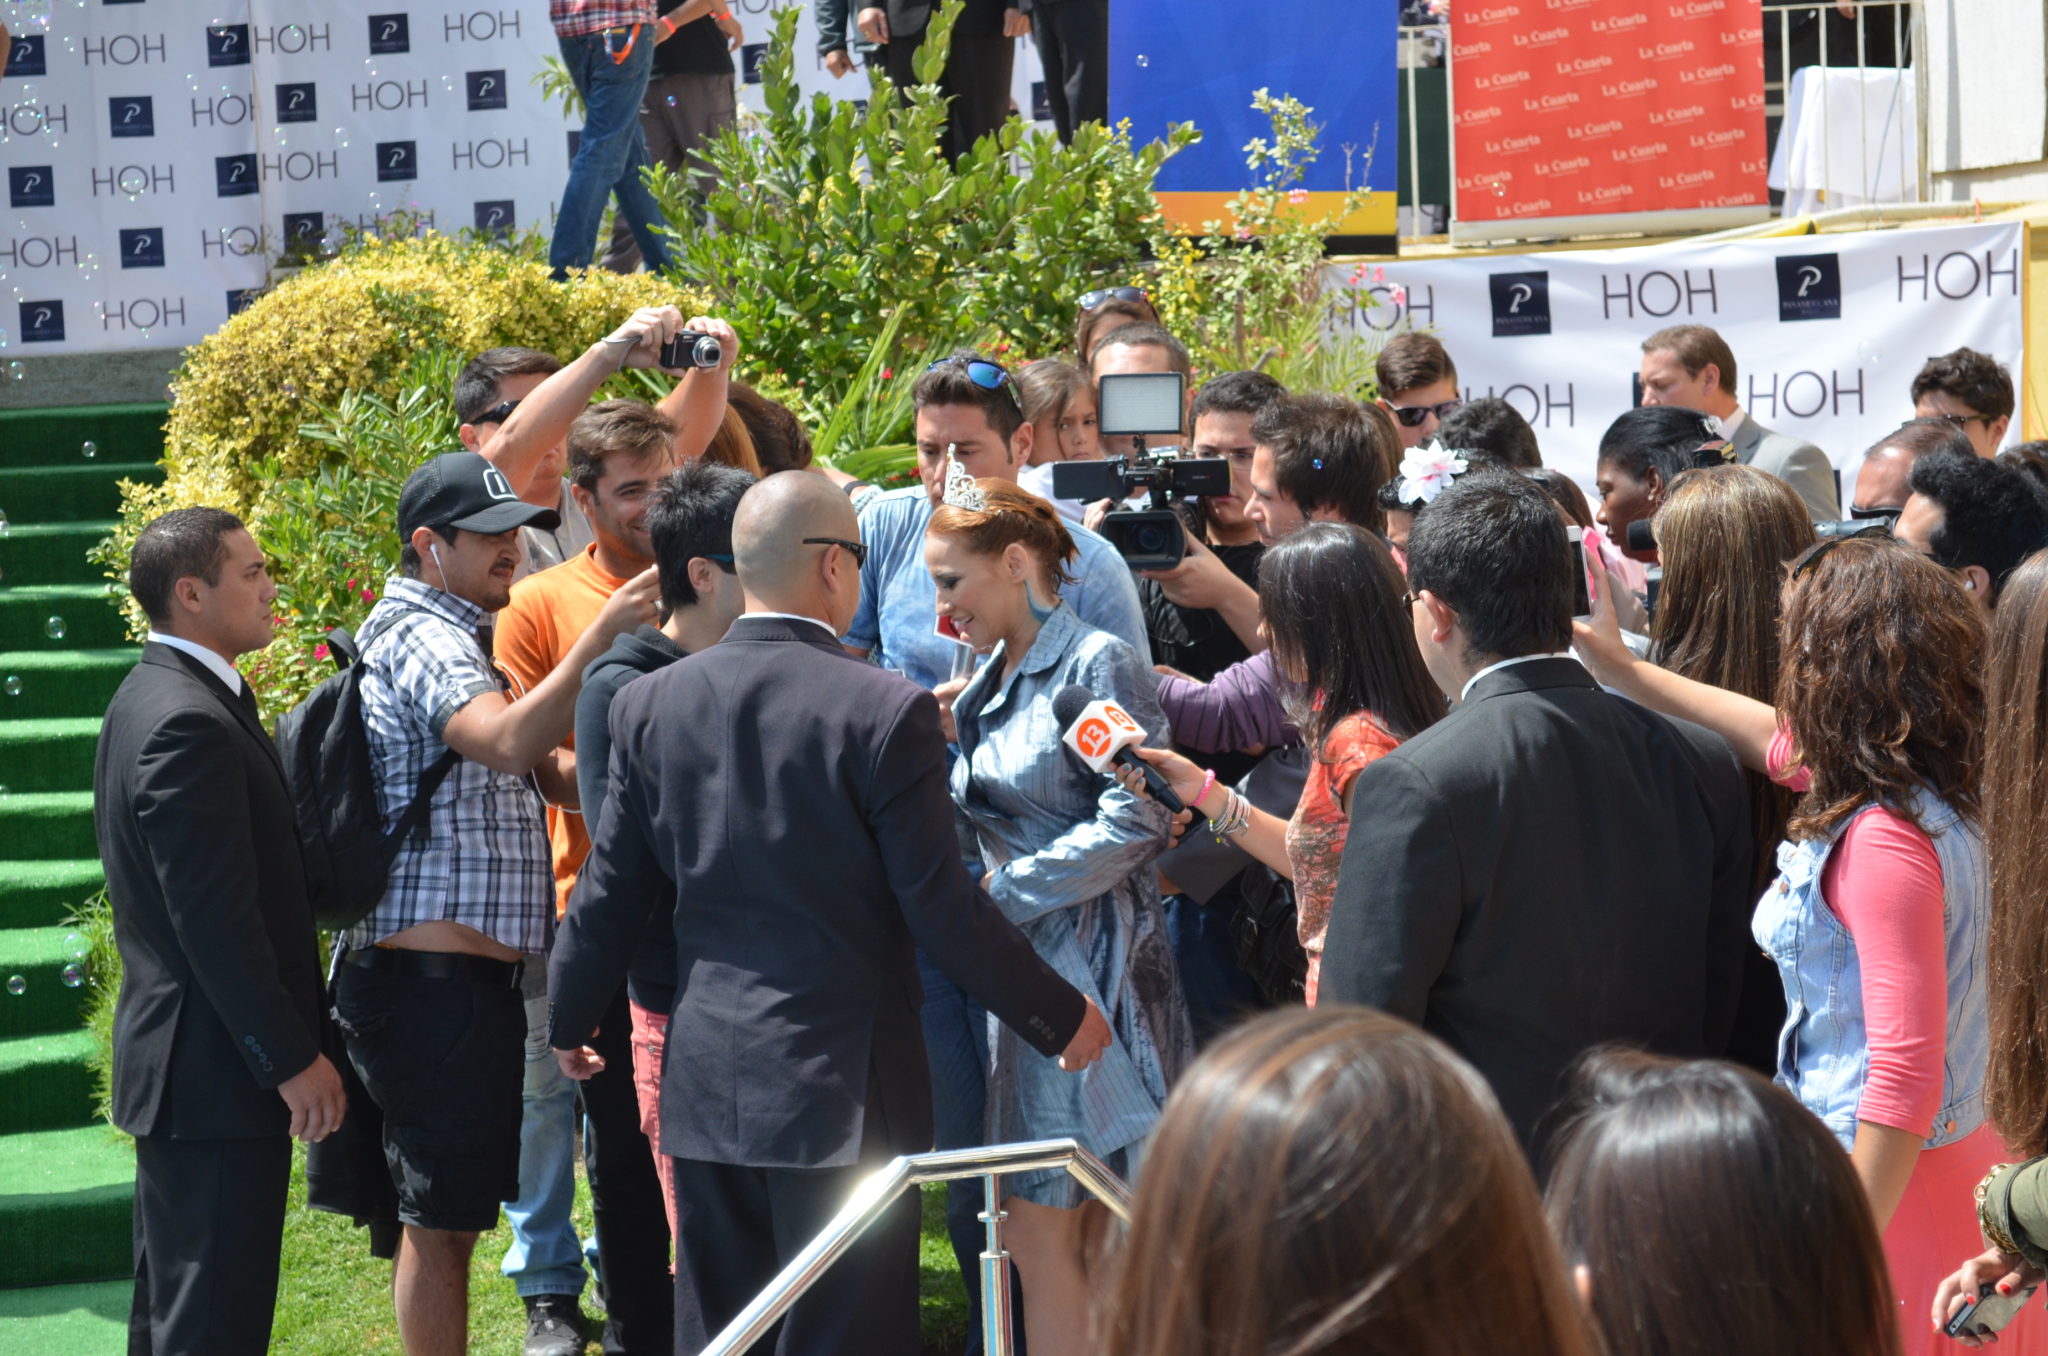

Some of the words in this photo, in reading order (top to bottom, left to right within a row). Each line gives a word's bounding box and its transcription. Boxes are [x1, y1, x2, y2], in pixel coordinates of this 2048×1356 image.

[1464, 12, 1479, 24] La
[1481, 6, 1520, 21] Cuarta
[1669, 6, 1684, 18] La
[1686, 0, 1725, 14] Cuarta
[443, 10, 520, 42] HOH
[1592, 20, 1607, 32] La
[1609, 13, 1648, 28] Cuarta
[253, 23, 331, 54] HOH
[1513, 35, 1528, 46] La
[1530, 28, 1569, 43] Cuarta
[1721, 32, 1736, 44] La
[83, 33, 166, 66] HOH
[1639, 47, 1654, 59] La
[1656, 40, 1694, 55] Cuarta
[1556, 63, 1572, 74] La
[1574, 55, 1613, 70] Cuarta
[1680, 71, 1695, 82] La
[1697, 64, 1736, 79] Cuarta
[1475, 77, 1490, 89] La
[1492, 70, 1531, 85] Cuarta
[1602, 85, 1617, 97] La
[1619, 78, 1658, 93] Cuarta
[351, 79, 428, 112] HOH
[1524, 99, 1539, 111] La
[1541, 92, 1580, 107] Cuarta
[1731, 98, 1746, 109] La
[1463, 107, 1503, 122] Cuarta
[1649, 112, 1664, 124] La
[1666, 105, 1705, 120] Cuarta
[1567, 127, 1582, 138] La
[1584, 120, 1623, 135] Cuarta
[1690, 135, 1705, 147] La
[1707, 128, 1746, 143] Cuarta
[1485, 142, 1500, 153] La
[1502, 135, 1541, 150] Cuarta
[1612, 150, 1627, 161] La
[1629, 142, 1668, 158] Cuarta
[453, 138, 529, 170] HOH
[262, 151, 338, 182] HOH
[1534, 163, 1549, 175] La
[1552, 156, 1590, 172] Cuarta
[1740, 162, 1757, 173] La
[92, 164, 175, 197] HOH
[1457, 178, 1472, 189] La
[1474, 170, 1513, 186] Cuarta
[1659, 177, 1674, 188] La
[1676, 170, 1715, 185] Cuarta
[1577, 191, 1593, 203] La
[1595, 184, 1634, 199] Cuarta
[1496, 206, 1511, 217] La
[1513, 199, 1552, 214] Cuarta
[202, 225, 265, 258] HO
[1896, 248, 2018, 303] HOH
[1601, 268, 1718, 320] HOH
[102, 297, 186, 331] HOH
[1747, 368, 1864, 419] HOH
